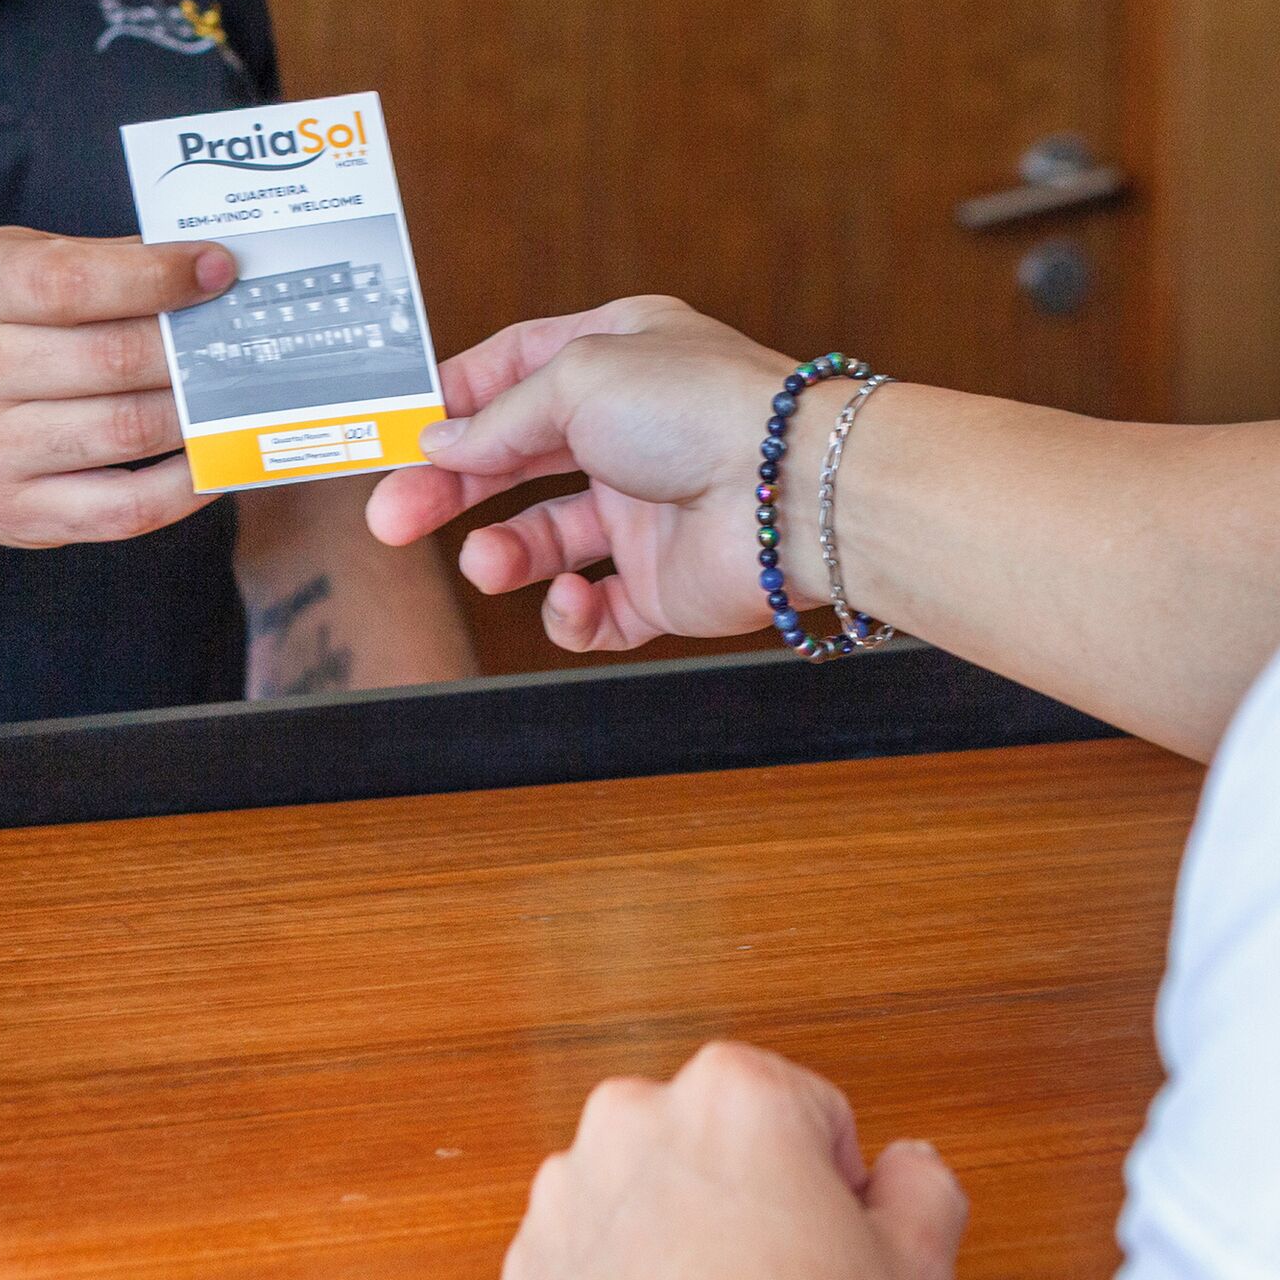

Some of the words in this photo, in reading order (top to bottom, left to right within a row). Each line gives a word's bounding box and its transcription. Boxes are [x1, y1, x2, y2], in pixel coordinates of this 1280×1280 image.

[178, 111, 368, 162] PraiaSol
[177, 208, 264, 230] BEM-VINDO
[288, 193, 364, 214] WELCOME
[224, 183, 310, 205] QUARTEIRA
